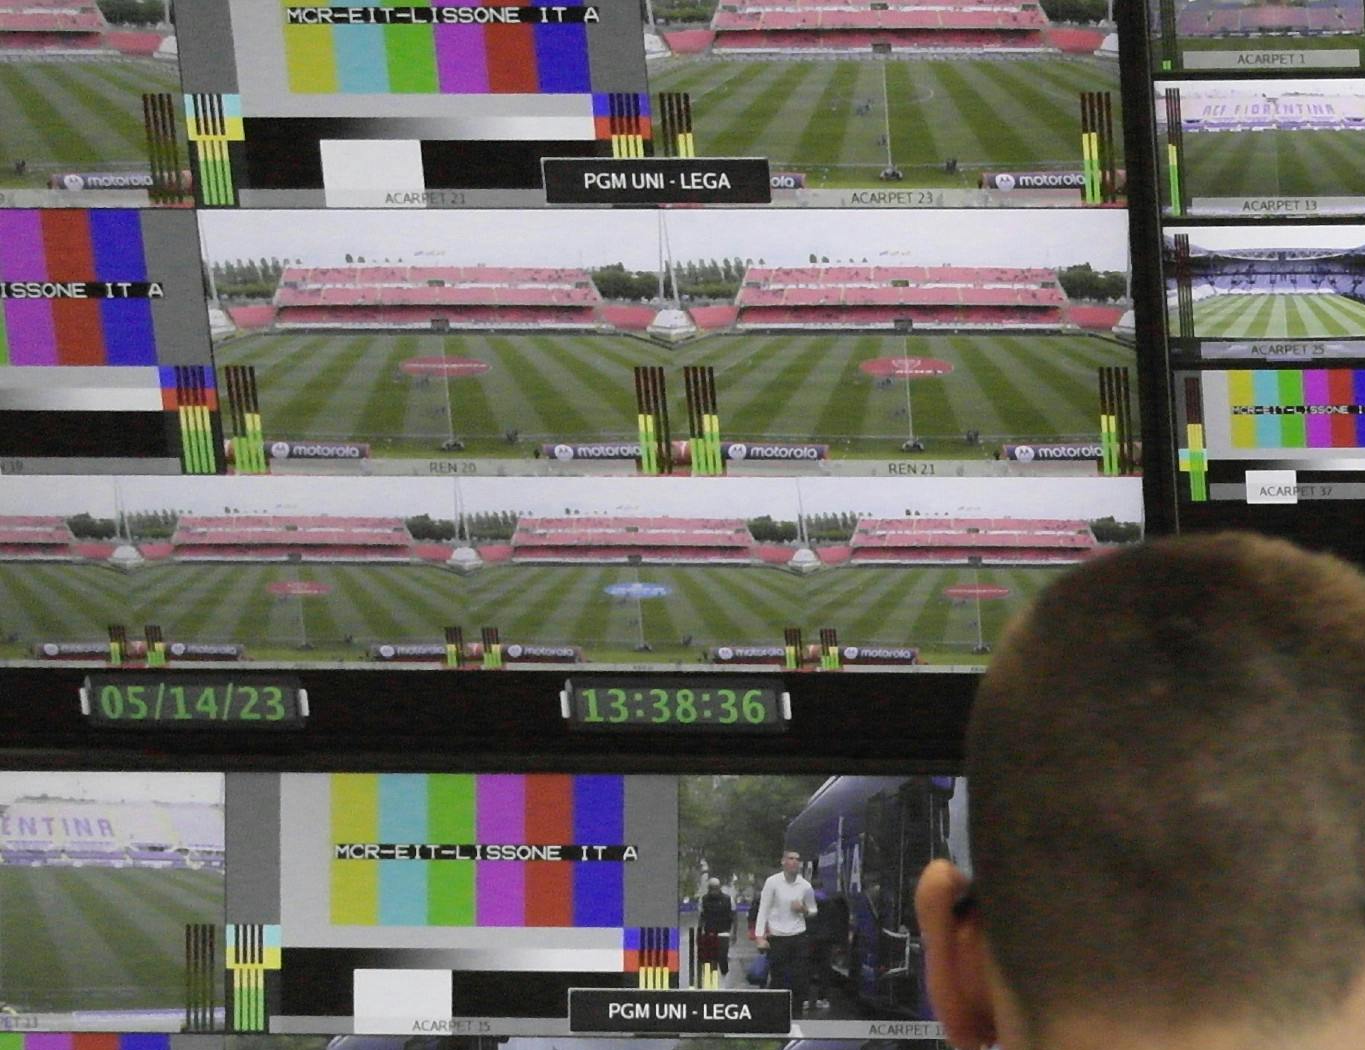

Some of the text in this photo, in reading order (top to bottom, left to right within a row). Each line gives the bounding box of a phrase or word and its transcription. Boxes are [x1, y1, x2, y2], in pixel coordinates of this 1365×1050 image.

[286, 8, 600, 23] MCR-EIT-LISSONE IT A
[1236, 53, 1306, 65] ACARPET 1
[584, 172, 629, 189] PGM
[633, 172, 664, 189] UNI
[681, 172, 730, 189] LEGA
[851, 192, 933, 204] ACARPET 23
[1242, 200, 1318, 211] ACARPET 13
[106, 283, 127, 298] IT
[148, 283, 164, 298] A
[293, 444, 359, 458] motorola
[750, 445, 817, 458] motorola
[889, 463, 935, 475] REN 21
[1259, 486, 1333, 497] ACARPET 37
[102, 683, 285, 722] 05/14/23
[581, 689, 766, 724] 13:38:36
[336, 845, 638, 860] MCR-EIT-LISSONE IT A
[608, 1003, 649, 1020] PGM
[655, 1003, 687, 1020] UNI
[703, 1004, 751, 1020] LEGA
